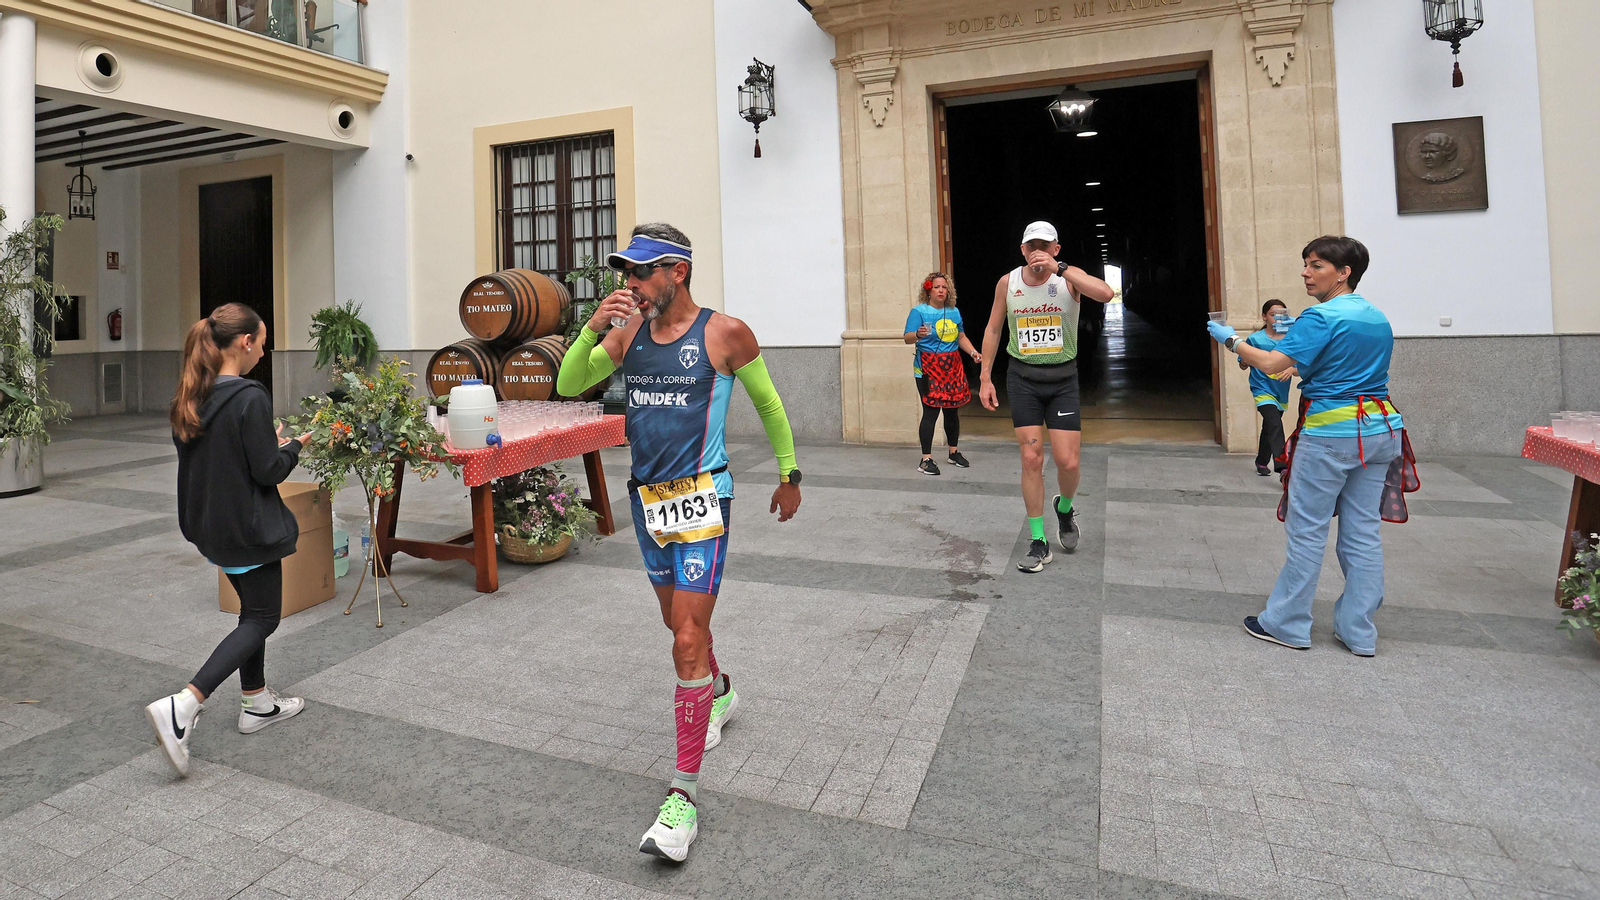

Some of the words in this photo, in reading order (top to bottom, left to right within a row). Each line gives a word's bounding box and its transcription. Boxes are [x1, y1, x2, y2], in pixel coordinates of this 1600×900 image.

[945, 14, 1024, 36] BODEGA
[1035, 7, 1062, 24] DE
[1073, 1, 1095, 18] MI
[466, 305, 480, 313] TIO
[482, 304, 512, 312] MATEO
[1013, 303, 1062, 314] maratón
[1025, 329, 1056, 342] 1575
[504, 375, 519, 383] TIO
[521, 375, 552, 383] MATEO
[627, 375, 654, 385] TOD@S
[663, 375, 696, 384] CORRER
[658, 495, 708, 526] 1163
[684, 701, 695, 724] RUN
